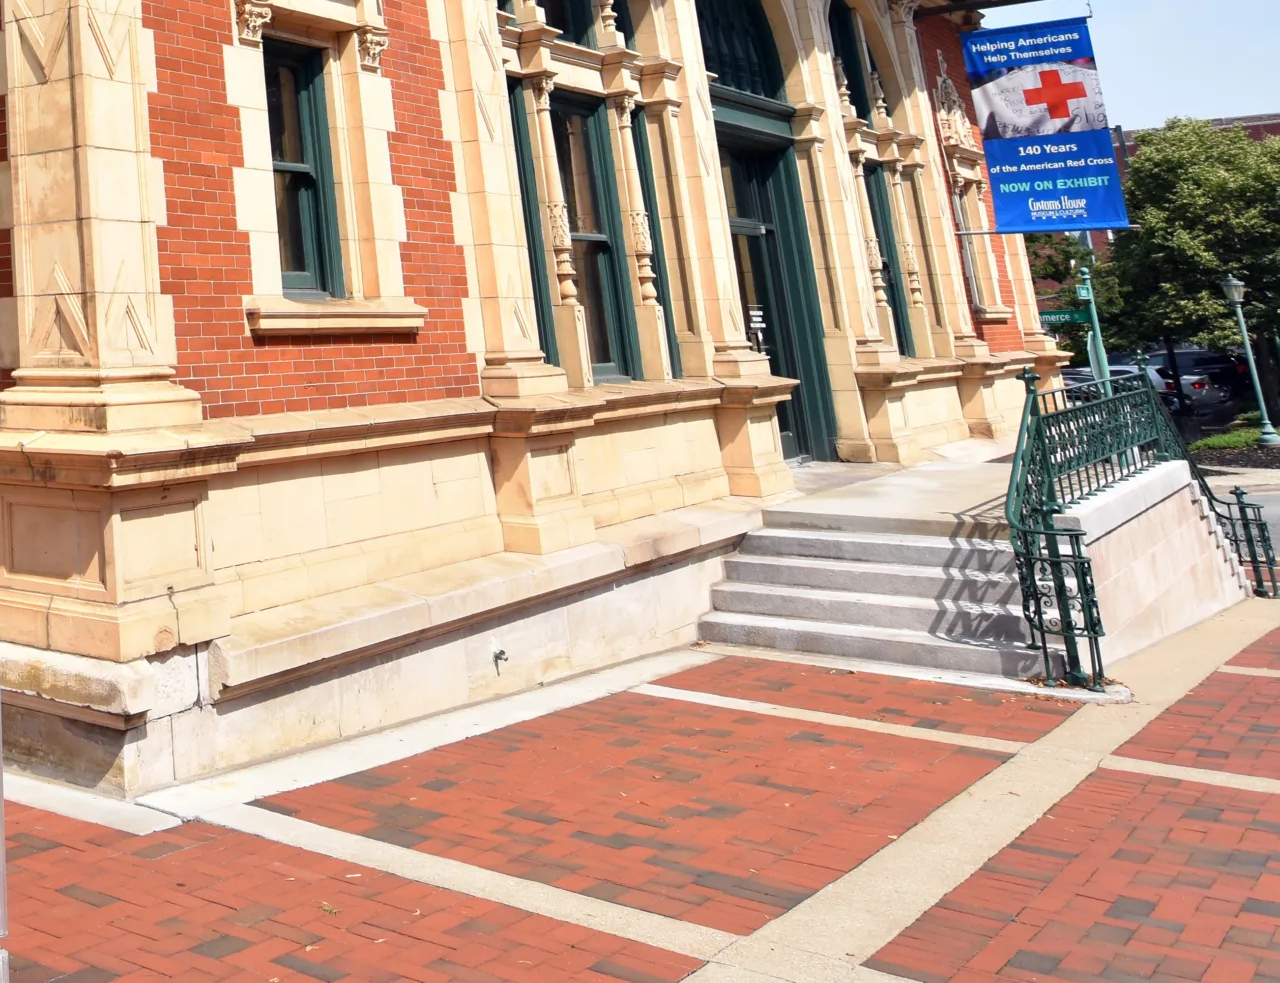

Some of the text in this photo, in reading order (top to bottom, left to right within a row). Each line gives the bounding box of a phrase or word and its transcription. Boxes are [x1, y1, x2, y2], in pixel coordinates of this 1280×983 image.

[972, 32, 1079, 53] Helping Americans
[984, 46, 1072, 63] Help Themselves
[1018, 143, 1078, 156] 140 Years
[990, 157, 1114, 173] of the American Red Cross
[1000, 176, 1110, 193] NOW ON EXHIBIT
[1028, 195, 1087, 211] Customs House
